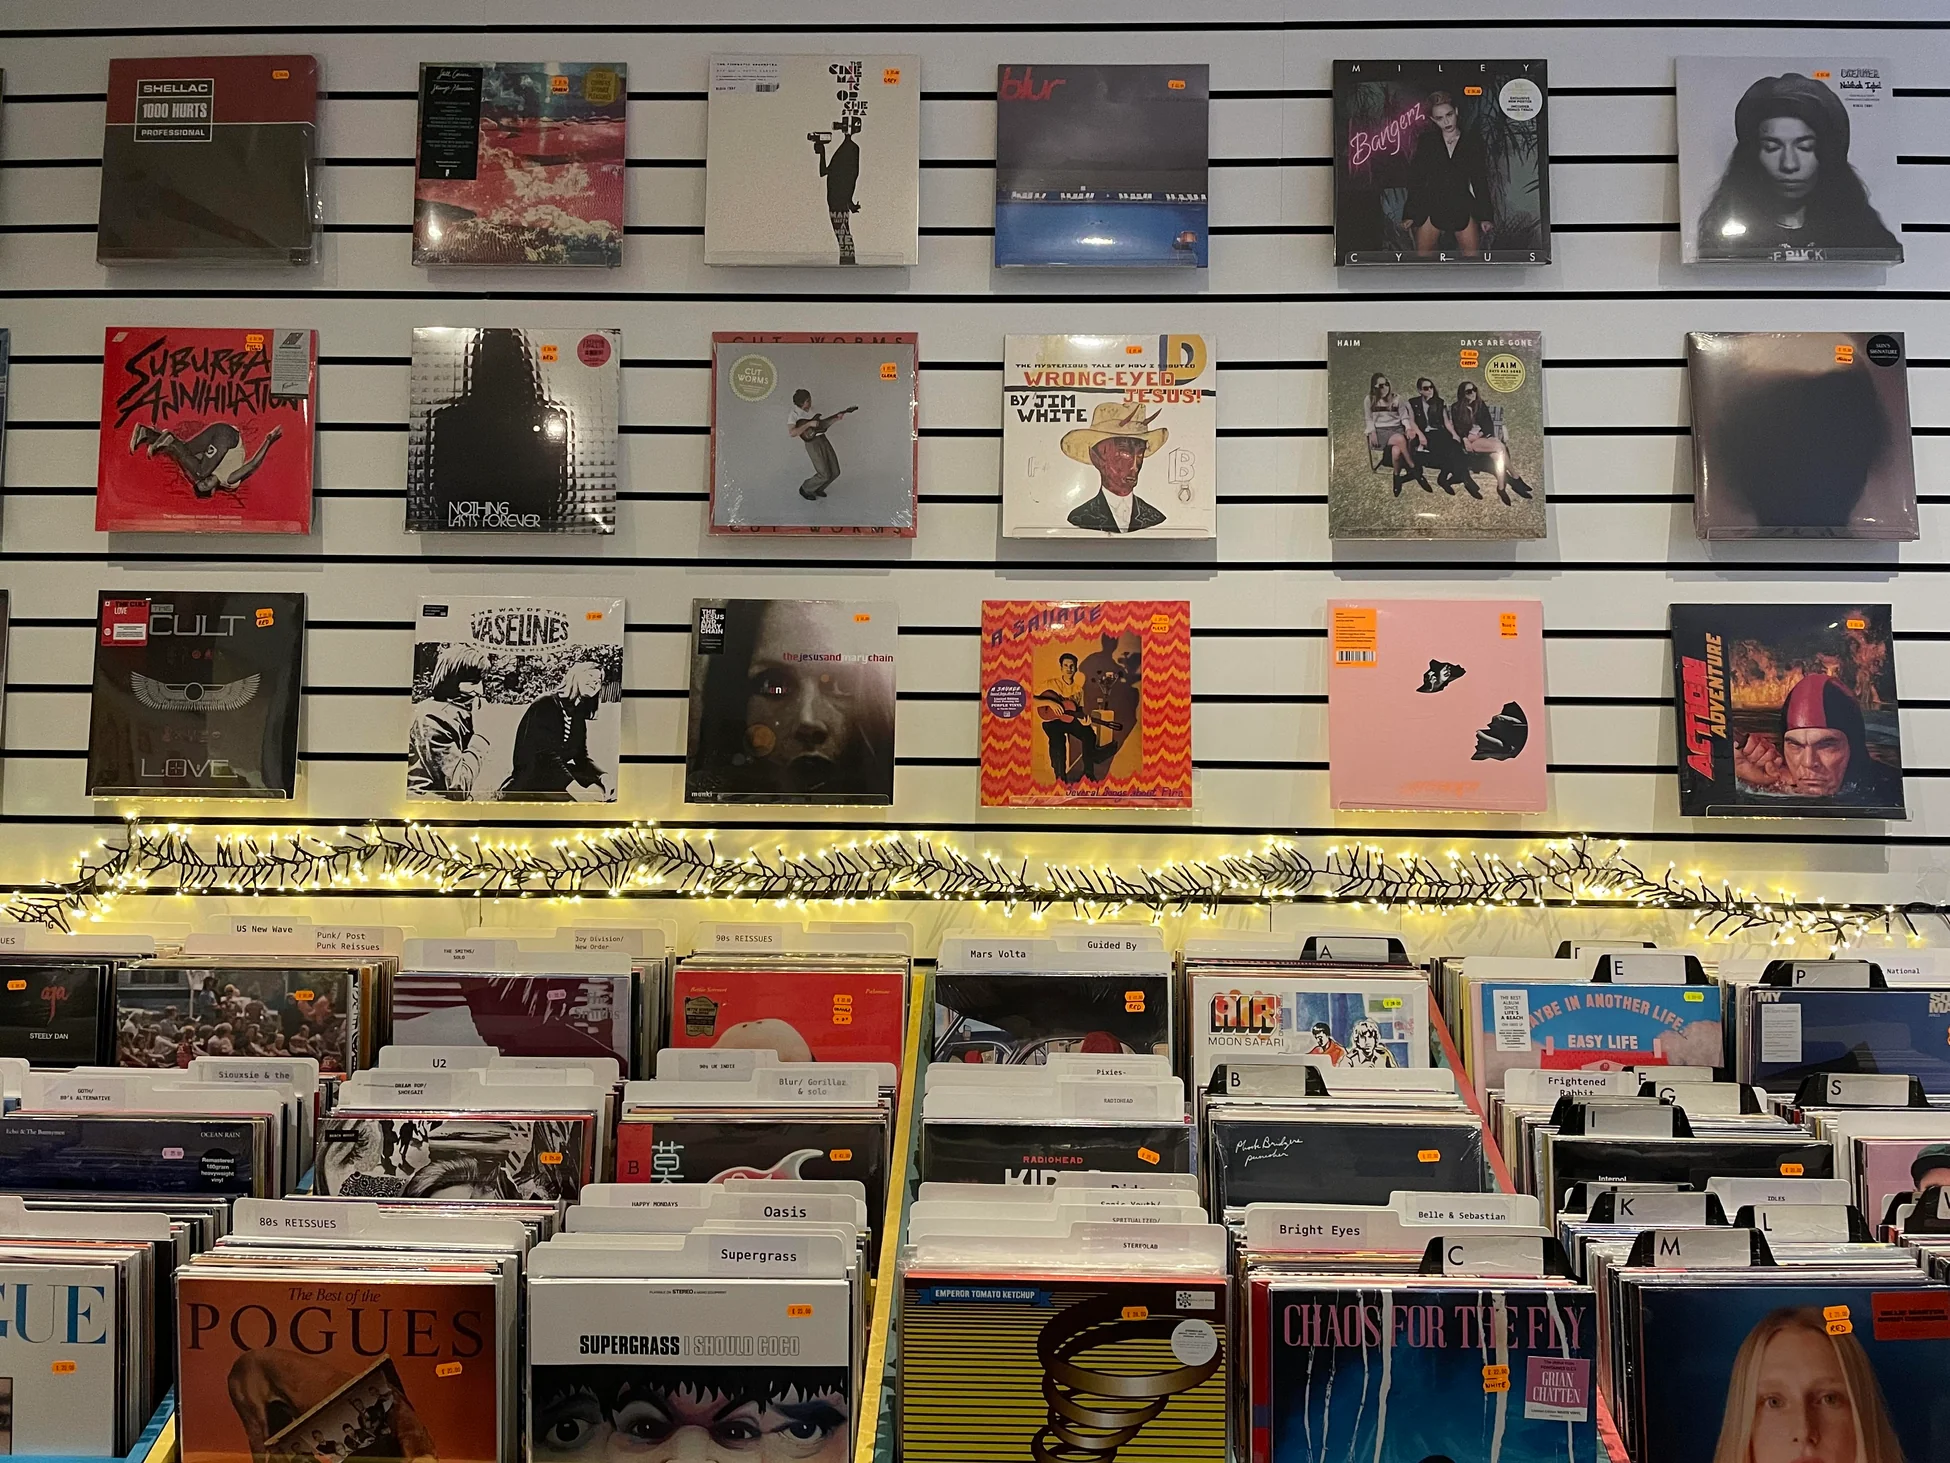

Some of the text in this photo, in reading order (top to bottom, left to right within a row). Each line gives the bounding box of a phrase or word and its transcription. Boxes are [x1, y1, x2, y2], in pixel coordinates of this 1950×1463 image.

[144, 84, 208, 93] SHELLAC
[998, 67, 1066, 101] blur
[143, 103, 207, 118] 1000 HURTS
[1350, 102, 1425, 165] Bangerz
[745, 367, 762, 375] CUT
[738, 374, 768, 385] WORMS
[1024, 371, 1176, 386] WRONG-EYED
[1010, 395, 1075, 408] BY JIM
[1124, 389, 1202, 403] JESUS!
[1017, 409, 1087, 422] WHITE
[448, 501, 509, 514] NOTHING
[448, 514, 540, 527] LASTS FOREVER
[114, 607, 128, 615] LOVE
[471, 609, 492, 618] THE
[149, 615, 246, 636] CULT
[470, 614, 569, 646] VASELINES
[1706, 633, 1726, 739] ADVENTURE
[1682, 656, 1714, 781] ACTION
[141, 759, 238, 777] LOVE
[317, 932, 366, 940] Punk/ Post
[735, 935, 773, 943] REISSUES
[317, 942, 337, 950] Punk
[1087, 941, 1137, 951] Guided By
[1319, 945, 1333, 959] A
[970, 950, 1026, 959] Mars Volta
[1615, 961, 1624, 975] E
[1796, 970, 1806, 984] P
[1758, 993, 1781, 1002] MY
[1210, 994, 1276, 1035] AIR
[30, 1032, 53, 1040] STEELY
[1208, 1038, 1284, 1047] MOON SAFARI
[1568, 1035, 1639, 1049] EASY LIFE
[432, 1059, 447, 1068] U2
[218, 1071, 259, 1079] Siouxsie
[1096, 1068, 1126, 1076] Pixies-
[1638, 1072, 1647, 1085] F
[779, 1077, 845, 1086] Blur/ Gorillaz
[1231, 1073, 1241, 1087] B
[1548, 1077, 1606, 1087] Frightened
[1831, 1080, 1842, 1095] S
[1660, 1088, 1676, 1103] G
[1592, 1111, 1595, 1127] I
[1023, 1156, 1083, 1164] RADIOHEAD
[628, 1160, 639, 1175] B
[764, 1206, 806, 1218] Oasis
[1621, 1198, 1634, 1216] K
[1418, 1211, 1506, 1221] Belle & Sebastian
[1763, 1212, 1772, 1231] L
[259, 1218, 337, 1229] 80s REISSUES
[1280, 1225, 1360, 1237] Bright Eyes
[1123, 1242, 1158, 1250] STEREOLAB
[1660, 1237, 1681, 1256] M
[721, 1249, 797, 1263] Supergrass
[1448, 1246, 1464, 1266] C
[288, 1288, 381, 1303] The Best of the
[935, 1289, 1035, 1299] EMPEROR TOMATO KETCHUP
[186, 1303, 483, 1358] POGUES
[1284, 1304, 1586, 1350] CHAOS FOR THE FLY
[1830, 1324, 1846, 1333] RED
[579, 1335, 800, 1356] SUPERGRASS I SHOULD COCO
[1485, 1381, 1506, 1389] WHITE
[1541, 1371, 1574, 1387] GRIAN
[1532, 1386, 1581, 1403] CHATTEN
